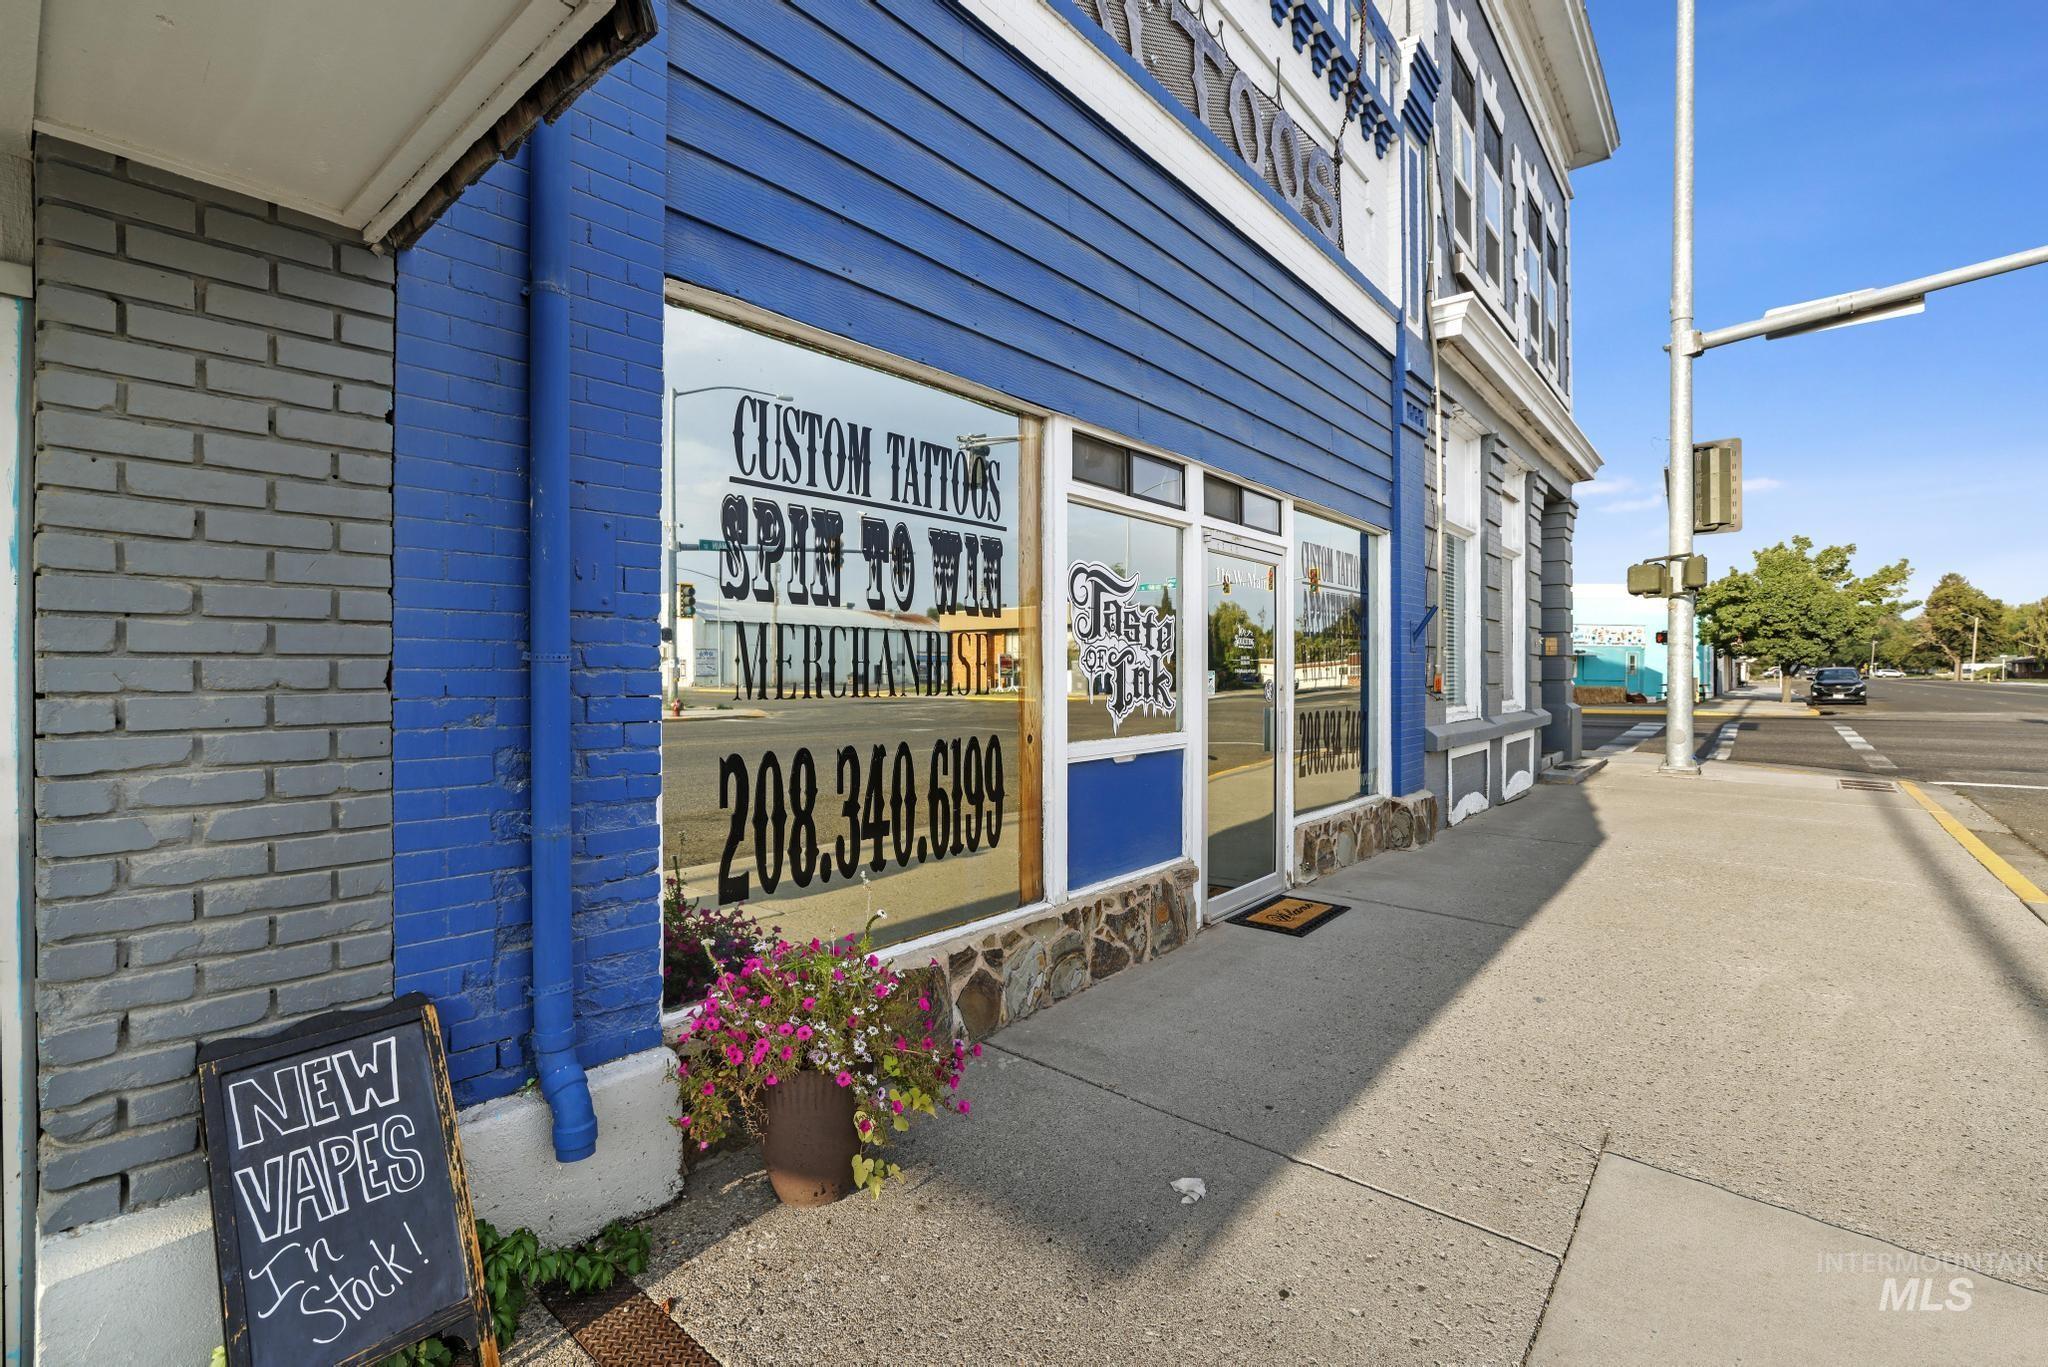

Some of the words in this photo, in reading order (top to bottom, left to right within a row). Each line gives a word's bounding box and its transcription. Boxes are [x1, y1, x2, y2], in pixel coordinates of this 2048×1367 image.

[733, 394, 872, 498] CUSTOM
[886, 432, 1001, 523] TATTOOS
[719, 493, 844, 608] SPIN
[860, 516, 916, 612] TO
[928, 527, 1004, 618] WIN
[1215, 567, 1231, 585] 116
[1301, 541, 1334, 584] CUSTOM
[1068, 560, 1175, 655] Taste
[733, 620, 990, 700] MERCHANDISE
[1084, 647, 1107, 671] OF
[1107, 648, 1175, 714] Ink
[718, 734, 1005, 906] 208.340.6199
[228, 1036, 400, 1150] NEW
[234, 1114, 426, 1243] VAPES
[248, 1237, 345, 1319] In
[300, 1221, 430, 1344] Stock!
